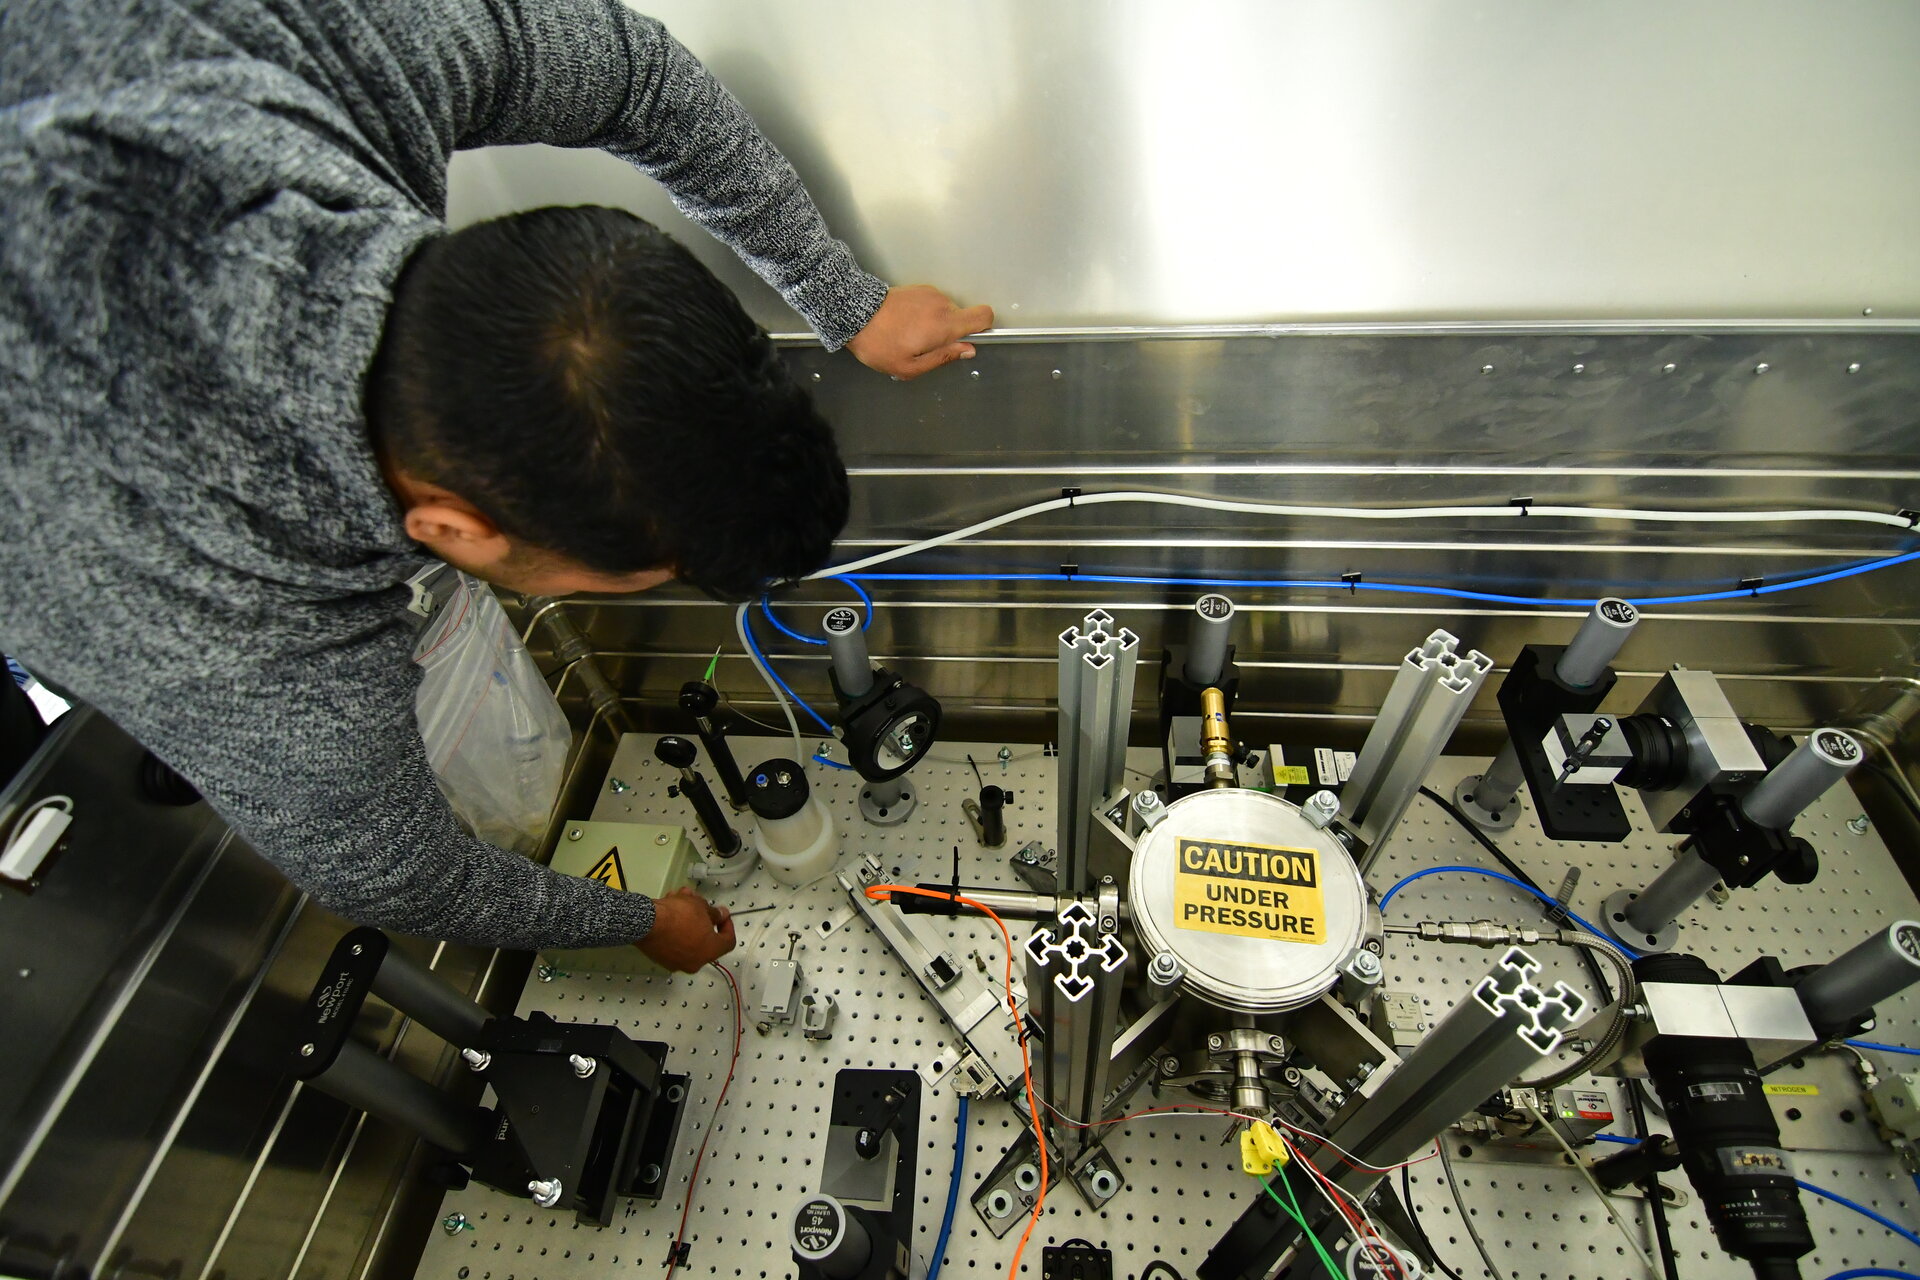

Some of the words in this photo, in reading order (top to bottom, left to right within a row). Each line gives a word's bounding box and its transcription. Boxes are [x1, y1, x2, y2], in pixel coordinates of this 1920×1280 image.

[1184, 846, 1312, 882] CAUTION
[1206, 884, 1289, 909] UNDER
[1184, 904, 1315, 935] PRESSURE
[318, 972, 349, 1024] Newport
[800, 1226, 832, 1236] Newport
[811, 1216, 824, 1226] 45
